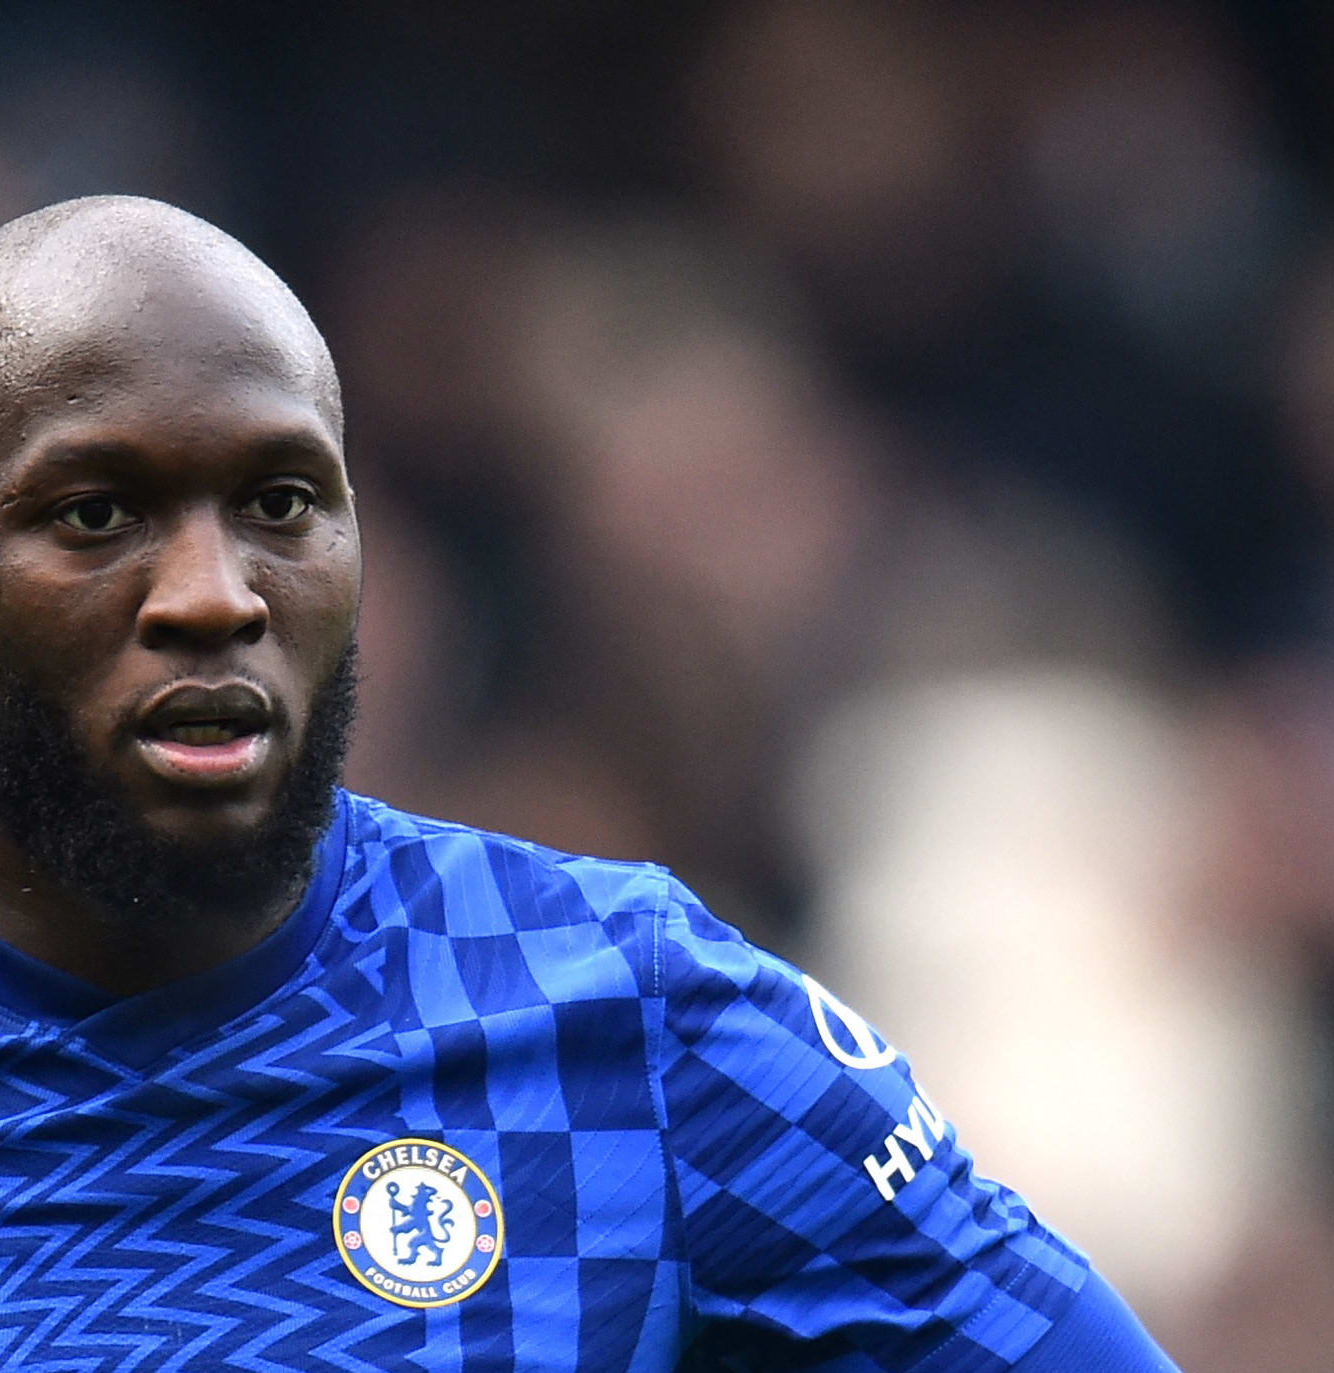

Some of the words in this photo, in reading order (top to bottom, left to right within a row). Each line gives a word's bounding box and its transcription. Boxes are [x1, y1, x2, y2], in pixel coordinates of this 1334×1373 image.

[362, 1146, 469, 1187] CHELSEA
[365, 1267, 438, 1298] FOOTBALL
[442, 1269, 476, 1294] CLUB
